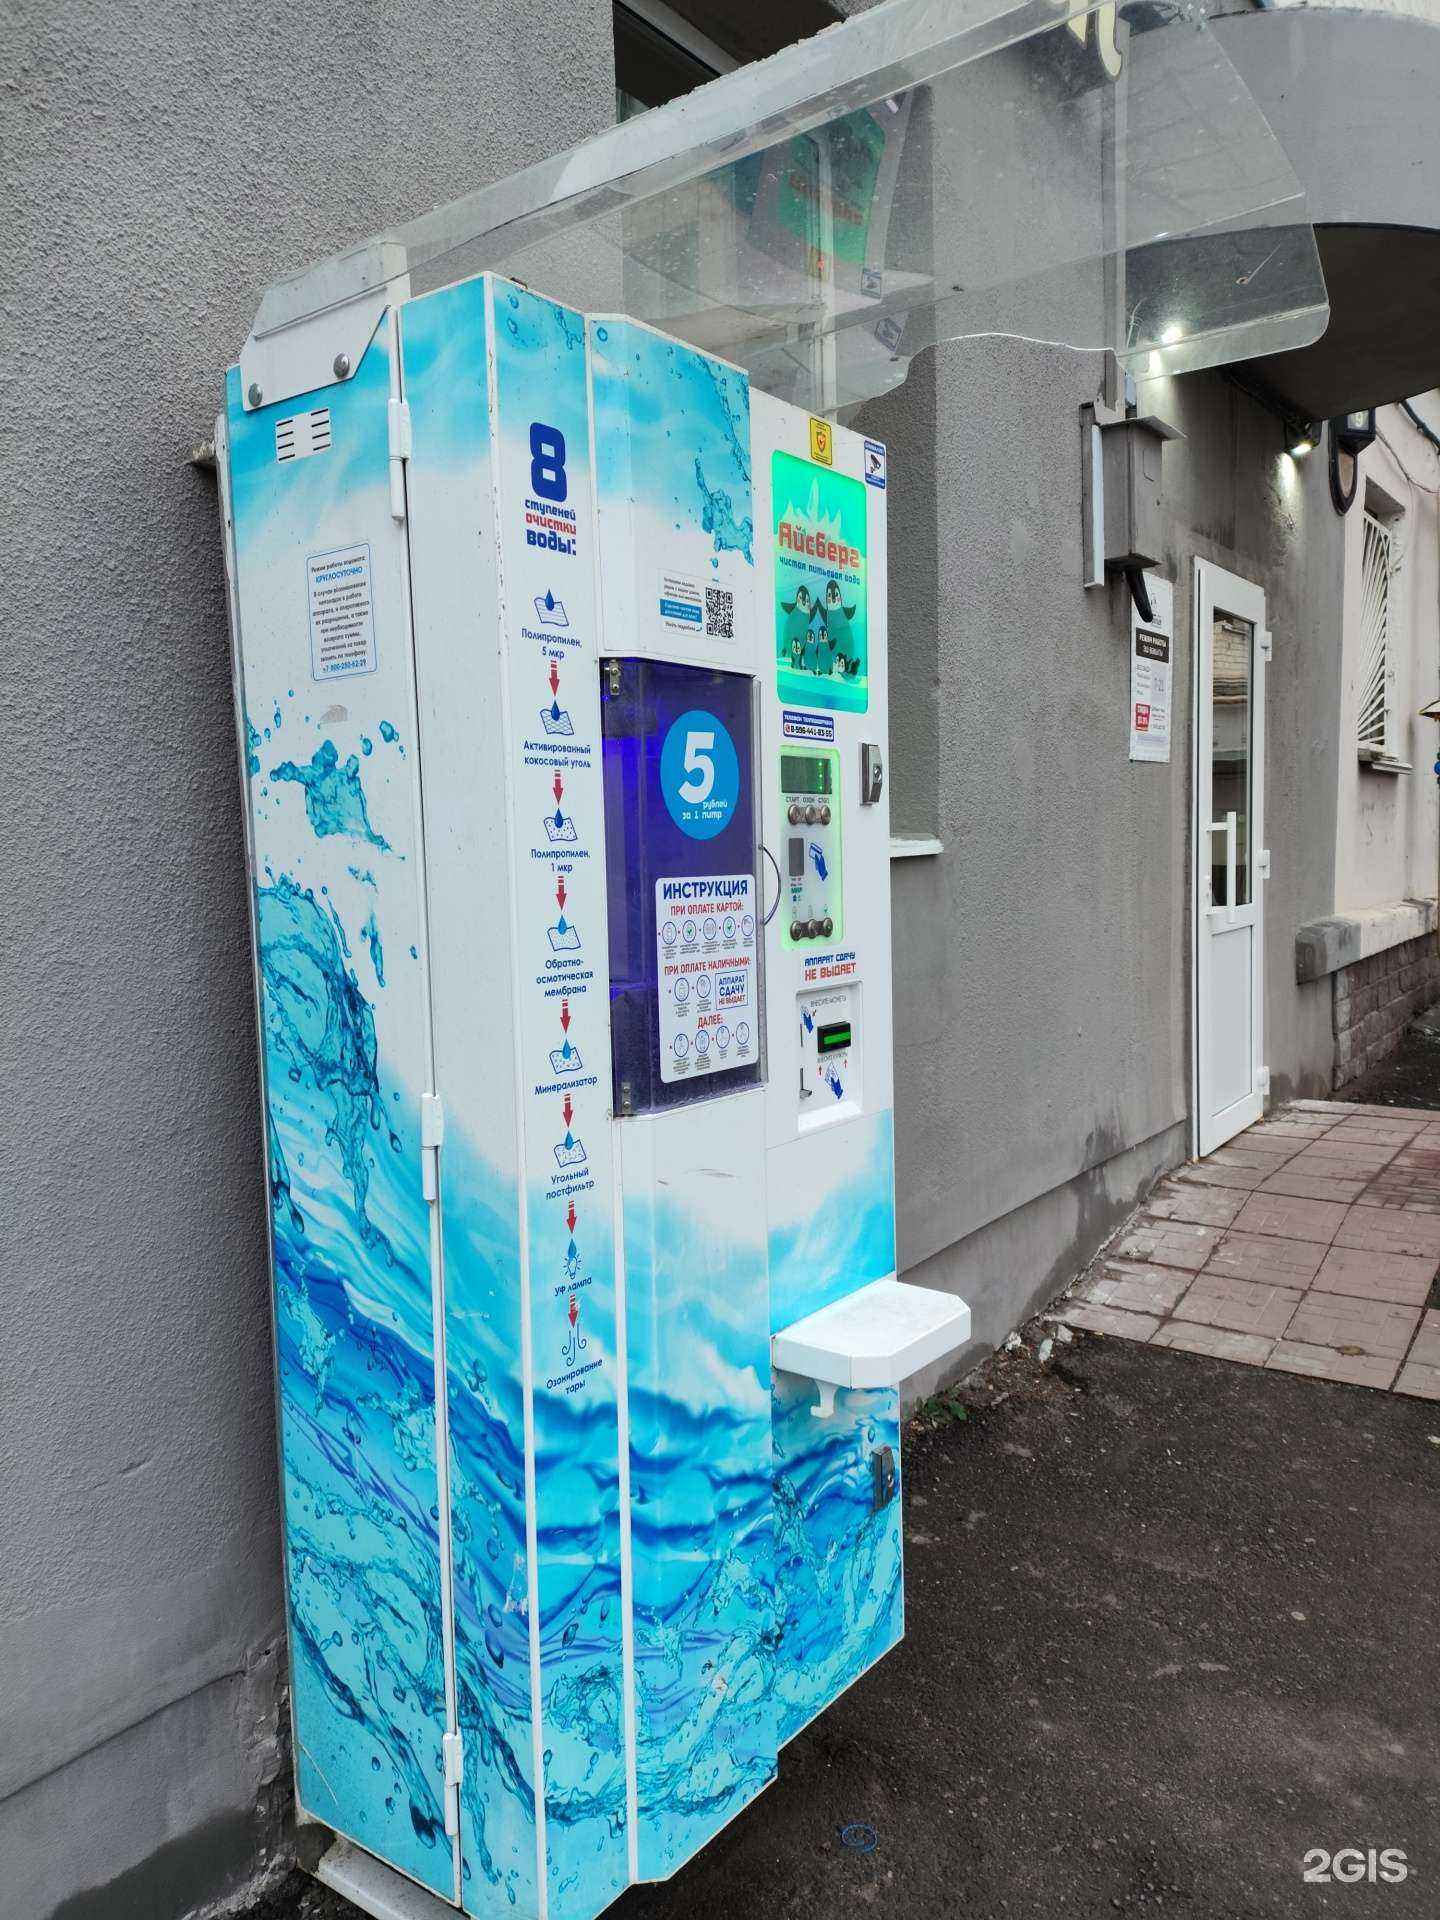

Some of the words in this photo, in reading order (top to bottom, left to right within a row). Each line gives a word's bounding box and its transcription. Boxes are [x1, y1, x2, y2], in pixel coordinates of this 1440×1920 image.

[529, 422, 568, 502] 8
[525, 499, 576, 521] ступеней
[525, 512, 576, 535] очистки
[526, 529, 576, 556] воды:
[779, 521, 860, 569] Айсберг
[780, 556, 806, 570] чистая
[521, 628, 582, 648] Полипропилен,
[542, 646, 547, 656] 5
[548, 649, 565, 660] мкр
[523, 740, 591, 755] Активированный
[524, 756, 569, 767] кокосовый
[570, 758, 591, 769] уголь
[678, 731, 715, 804] 5
[694, 811, 699, 819] 1
[702, 810, 722, 820] литр
[551, 863, 556, 871] 1
[557, 864, 573, 874] мкр
[663, 880, 748, 899] ИНСТРУКЦИЯ
[671, 905, 686, 916] ПРИ
[687, 903, 715, 915] ОПЛАТЕ
[716, 899, 744, 912] КАРТОЙ:
[545, 959, 584, 970] Обратно-
[664, 965, 679, 976] ПРИ
[680, 961, 707, 974] ОПЛАТЕ
[708, 956, 752, 971] НАЛИЧНЫМИ:
[804, 955, 833, 966] АППАРАТ
[835, 951, 856, 961] СДАЧУ
[536, 970, 594, 985] осмотическая
[804, 968, 817, 981] НЕ
[820, 962, 857, 979] ВЫДАЕТ
[718, 975, 745, 986] АППАРАТ
[544, 985, 587, 998] мембрана
[719, 984, 745, 997] СДАЧУ
[698, 1013, 724, 1029] ДАЛЕЕ:
[534, 1075, 598, 1095] Минерализатор
[550, 1167, 589, 1184] Угольный
[545, 1179, 595, 1200] постфильтр
[567, 1275, 593, 1293] лампа
[565, 1379, 586, 1394] тары
